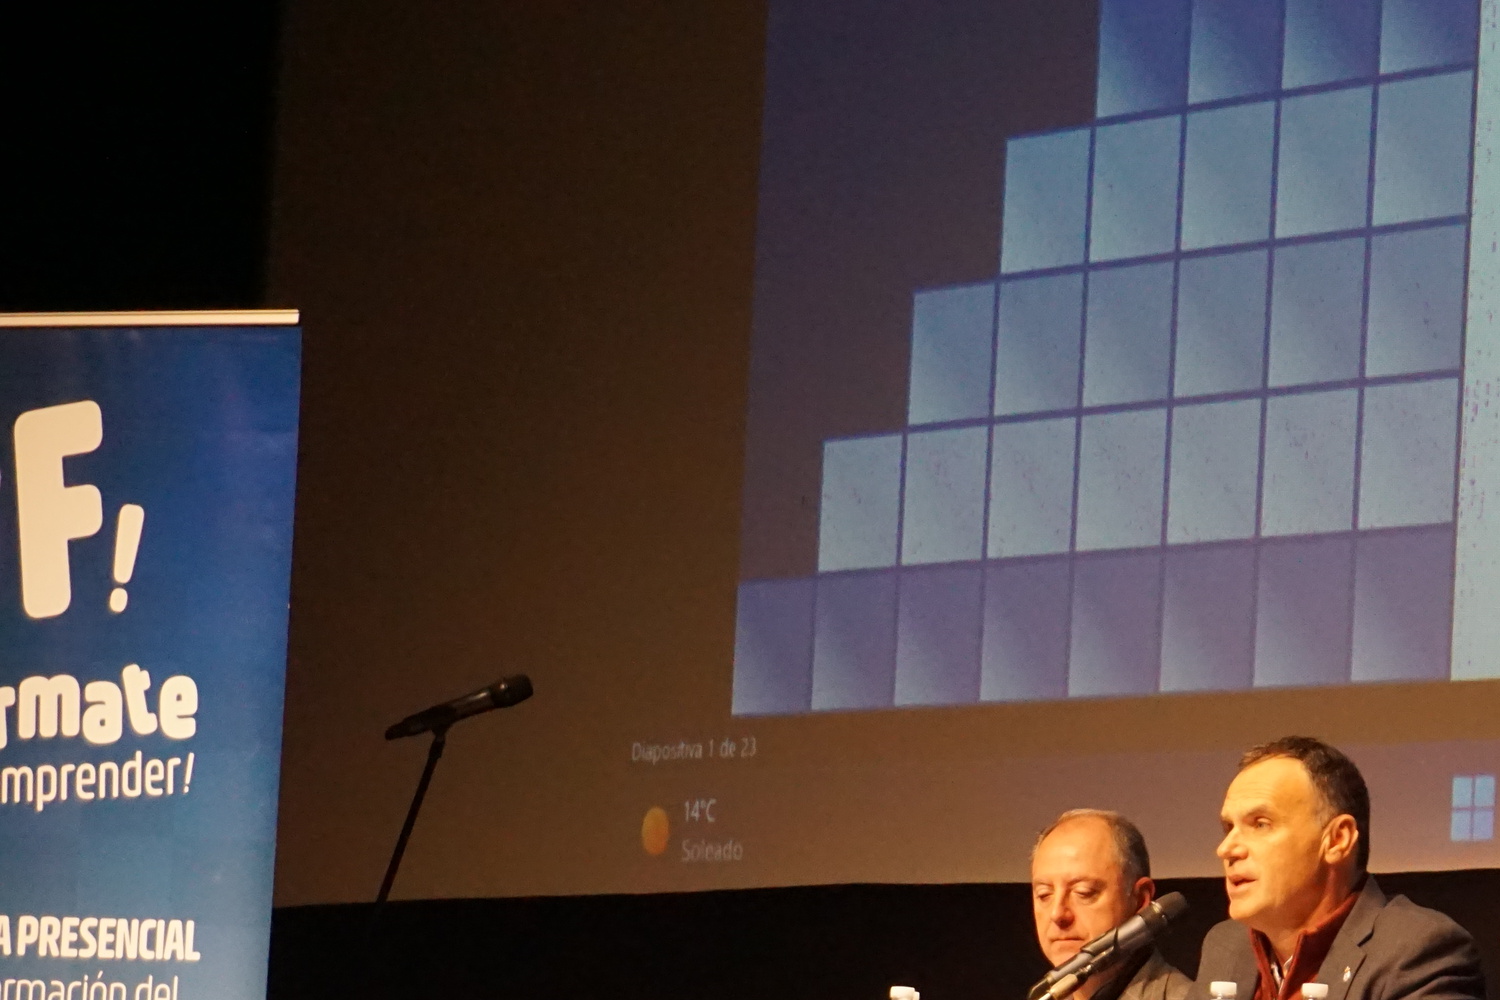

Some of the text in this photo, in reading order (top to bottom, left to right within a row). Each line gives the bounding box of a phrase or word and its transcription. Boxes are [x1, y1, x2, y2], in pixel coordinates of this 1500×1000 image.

[720, 738, 736, 758] de
[740, 736, 757, 758] 23
[681, 839, 744, 863] Soleado
[17, 915, 201, 962] PRESENCIAL
